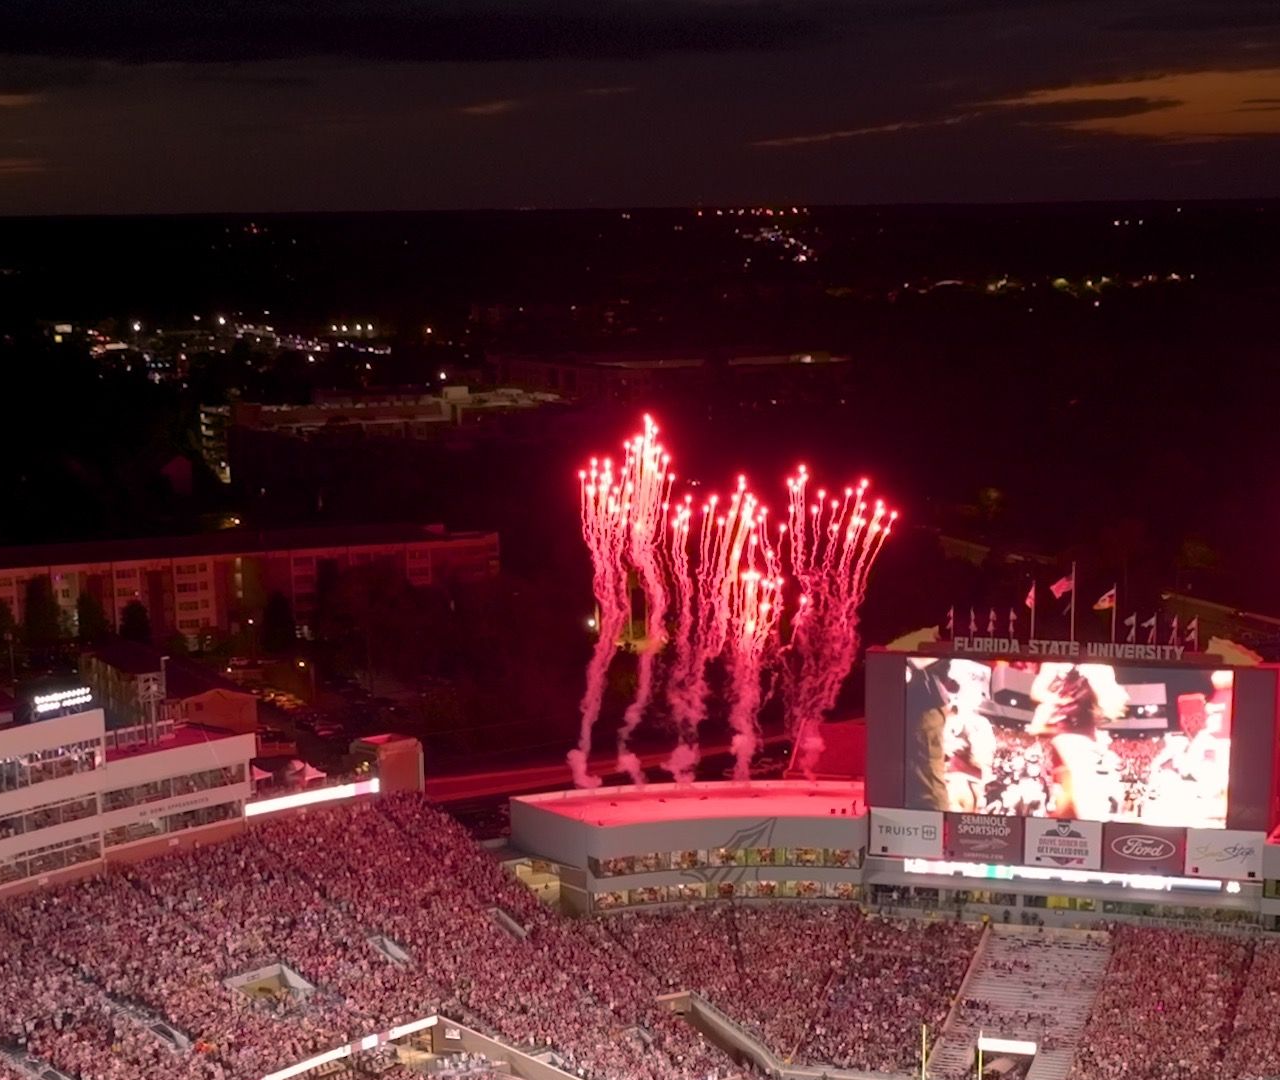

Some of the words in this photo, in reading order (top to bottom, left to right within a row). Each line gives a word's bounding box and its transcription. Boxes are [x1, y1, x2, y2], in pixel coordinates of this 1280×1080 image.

[953, 637, 1020, 653] FLORIDA
[1028, 639, 1079, 657] STATE
[1086, 642, 1185, 661] UNIVERSITY
[961, 815, 1007, 827] SEMINOLE
[878, 824, 920, 837] TRUIST
[957, 824, 1011, 837] SPORTSHOP
[1122, 837, 1165, 857] Ford
